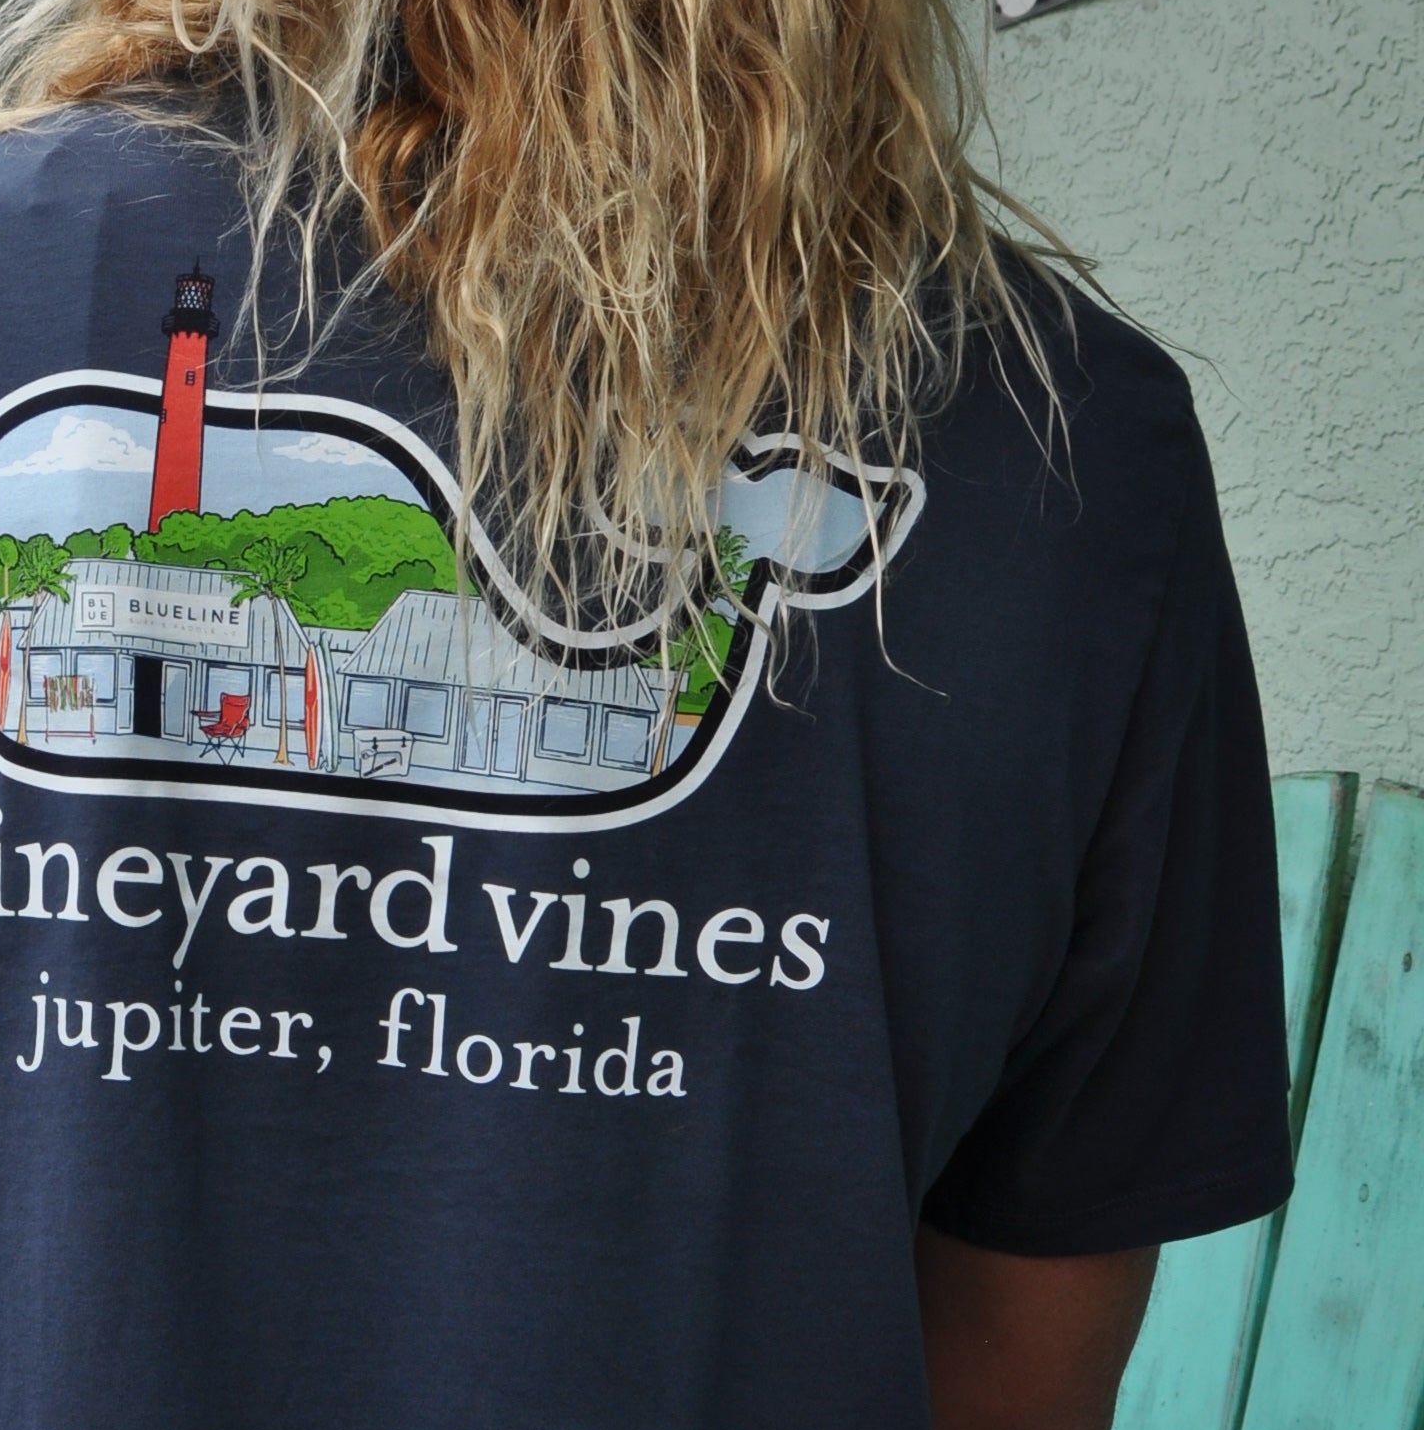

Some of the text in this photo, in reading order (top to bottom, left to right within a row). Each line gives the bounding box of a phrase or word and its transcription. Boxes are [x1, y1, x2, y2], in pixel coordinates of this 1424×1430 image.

[129, 598, 240, 625] BLUELINE
[481, 858, 830, 990] vines
[15, 970, 688, 1097] jupiter, florida
